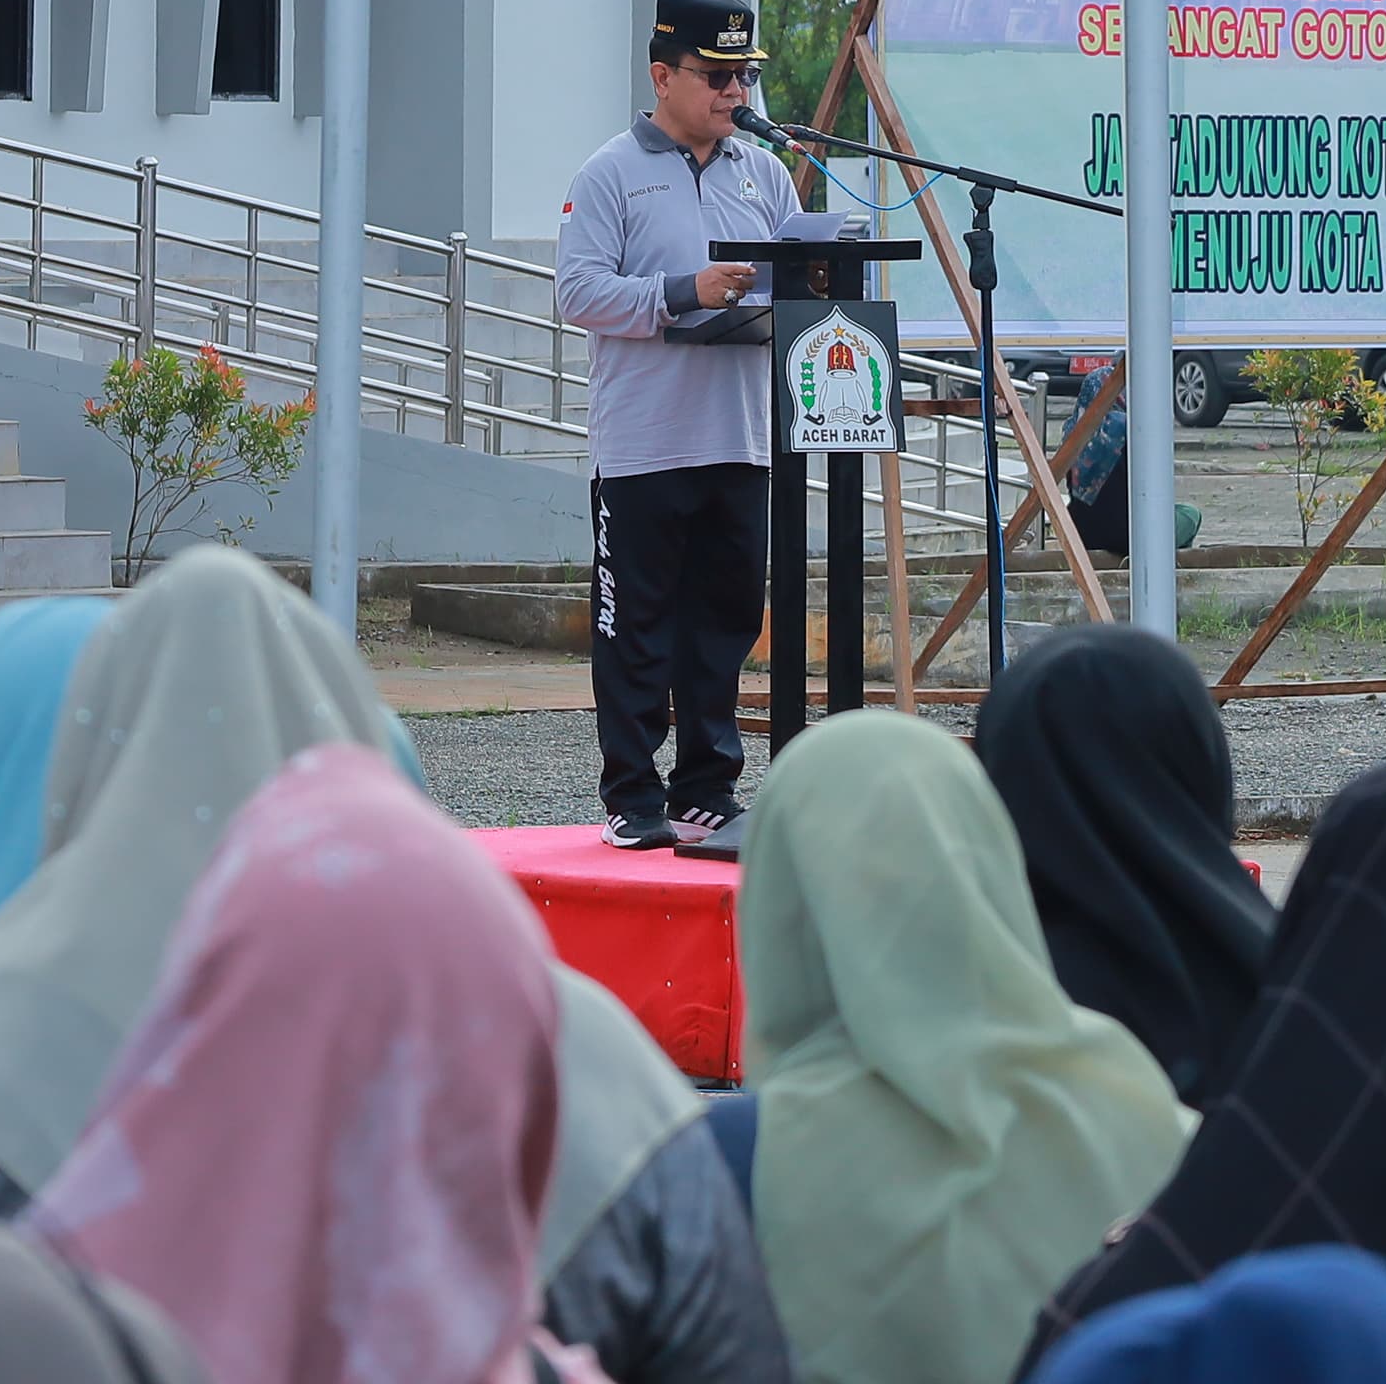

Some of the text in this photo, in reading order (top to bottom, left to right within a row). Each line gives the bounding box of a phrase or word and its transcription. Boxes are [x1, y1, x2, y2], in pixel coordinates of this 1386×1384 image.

[1078, 3, 1286, 58] SEANGAT
[1299, 211, 1382, 293] KOTA
[802, 429, 886, 442] ACEH BARAT
[597, 495, 617, 640] Aceh Barat
